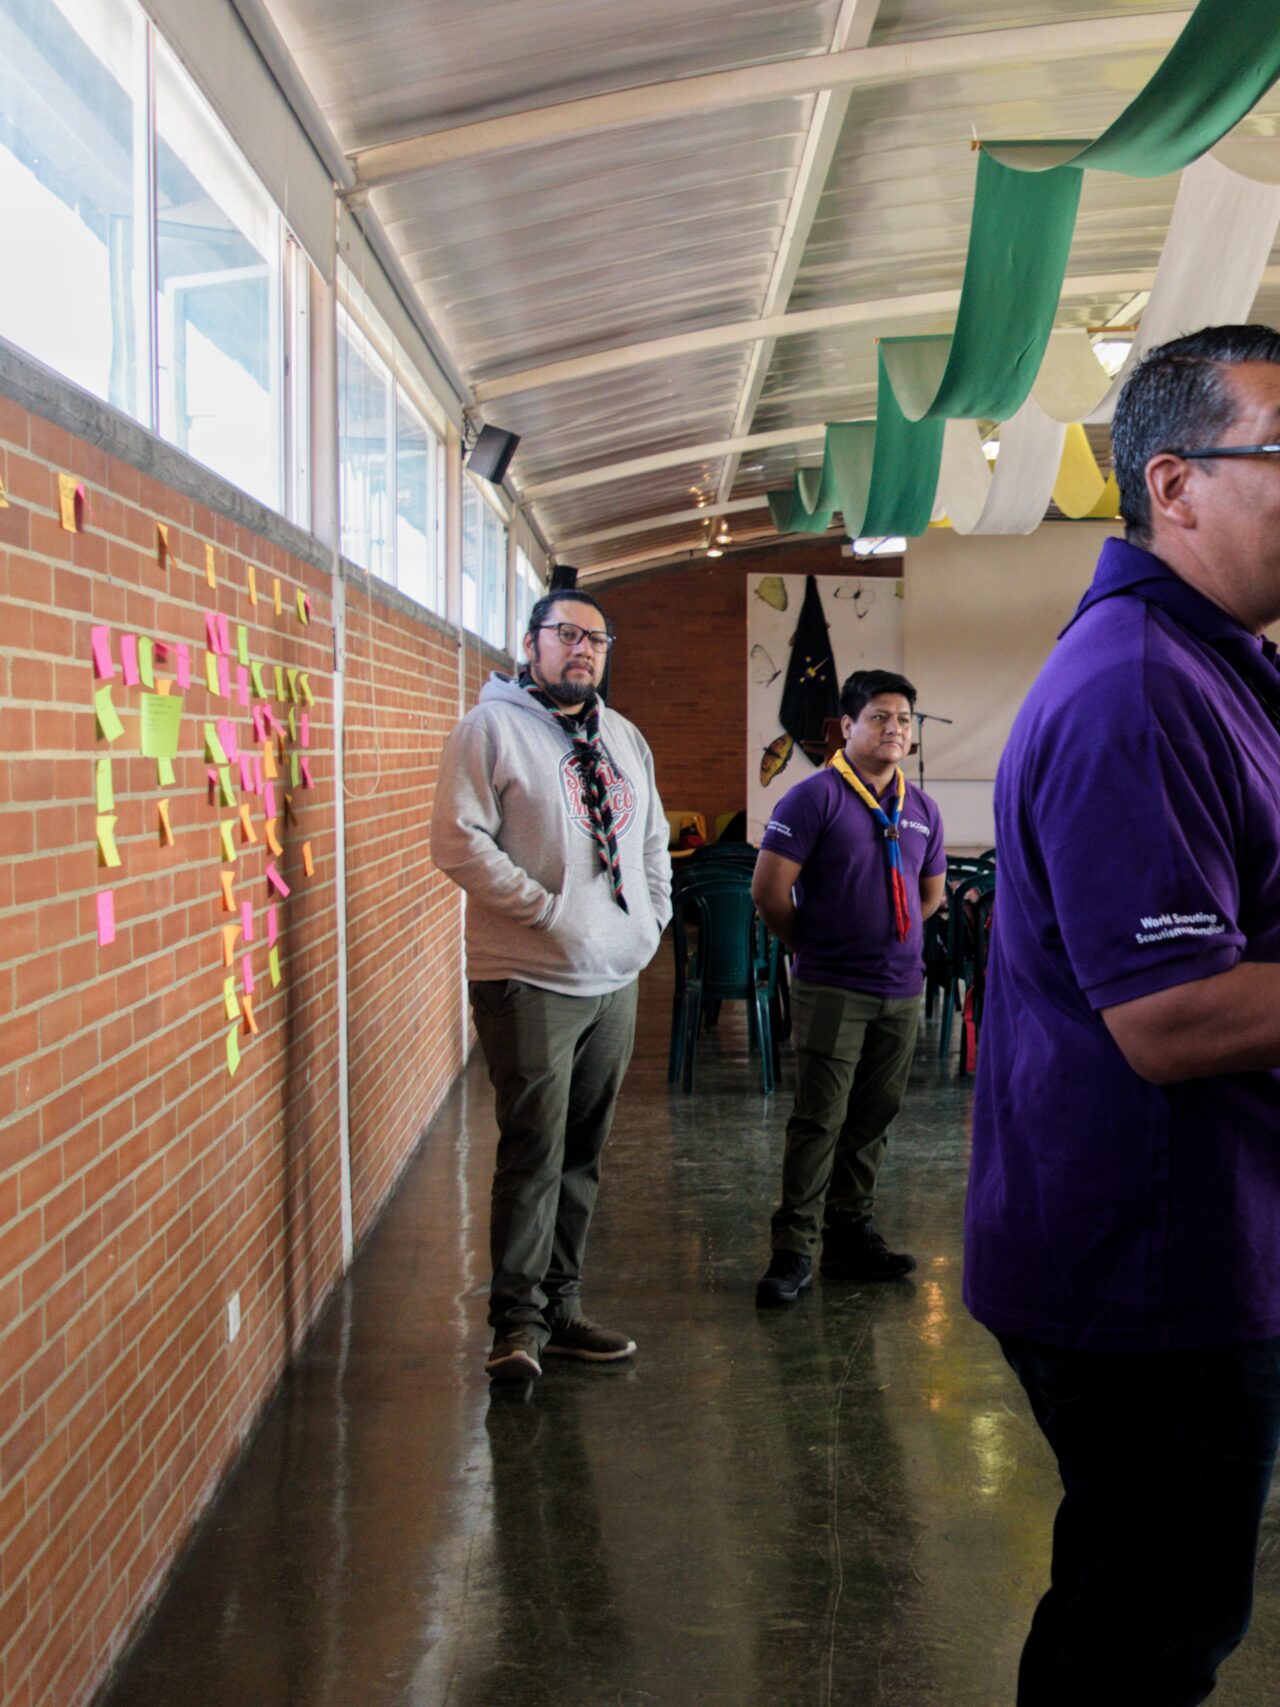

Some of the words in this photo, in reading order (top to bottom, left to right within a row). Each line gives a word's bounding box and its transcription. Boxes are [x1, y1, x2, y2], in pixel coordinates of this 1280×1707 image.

[570, 790, 633, 816] Mco
[1140, 914, 1172, 929] World
[1172, 912, 1217, 925] Scouting
[1135, 926, 1186, 944] Scoutism
